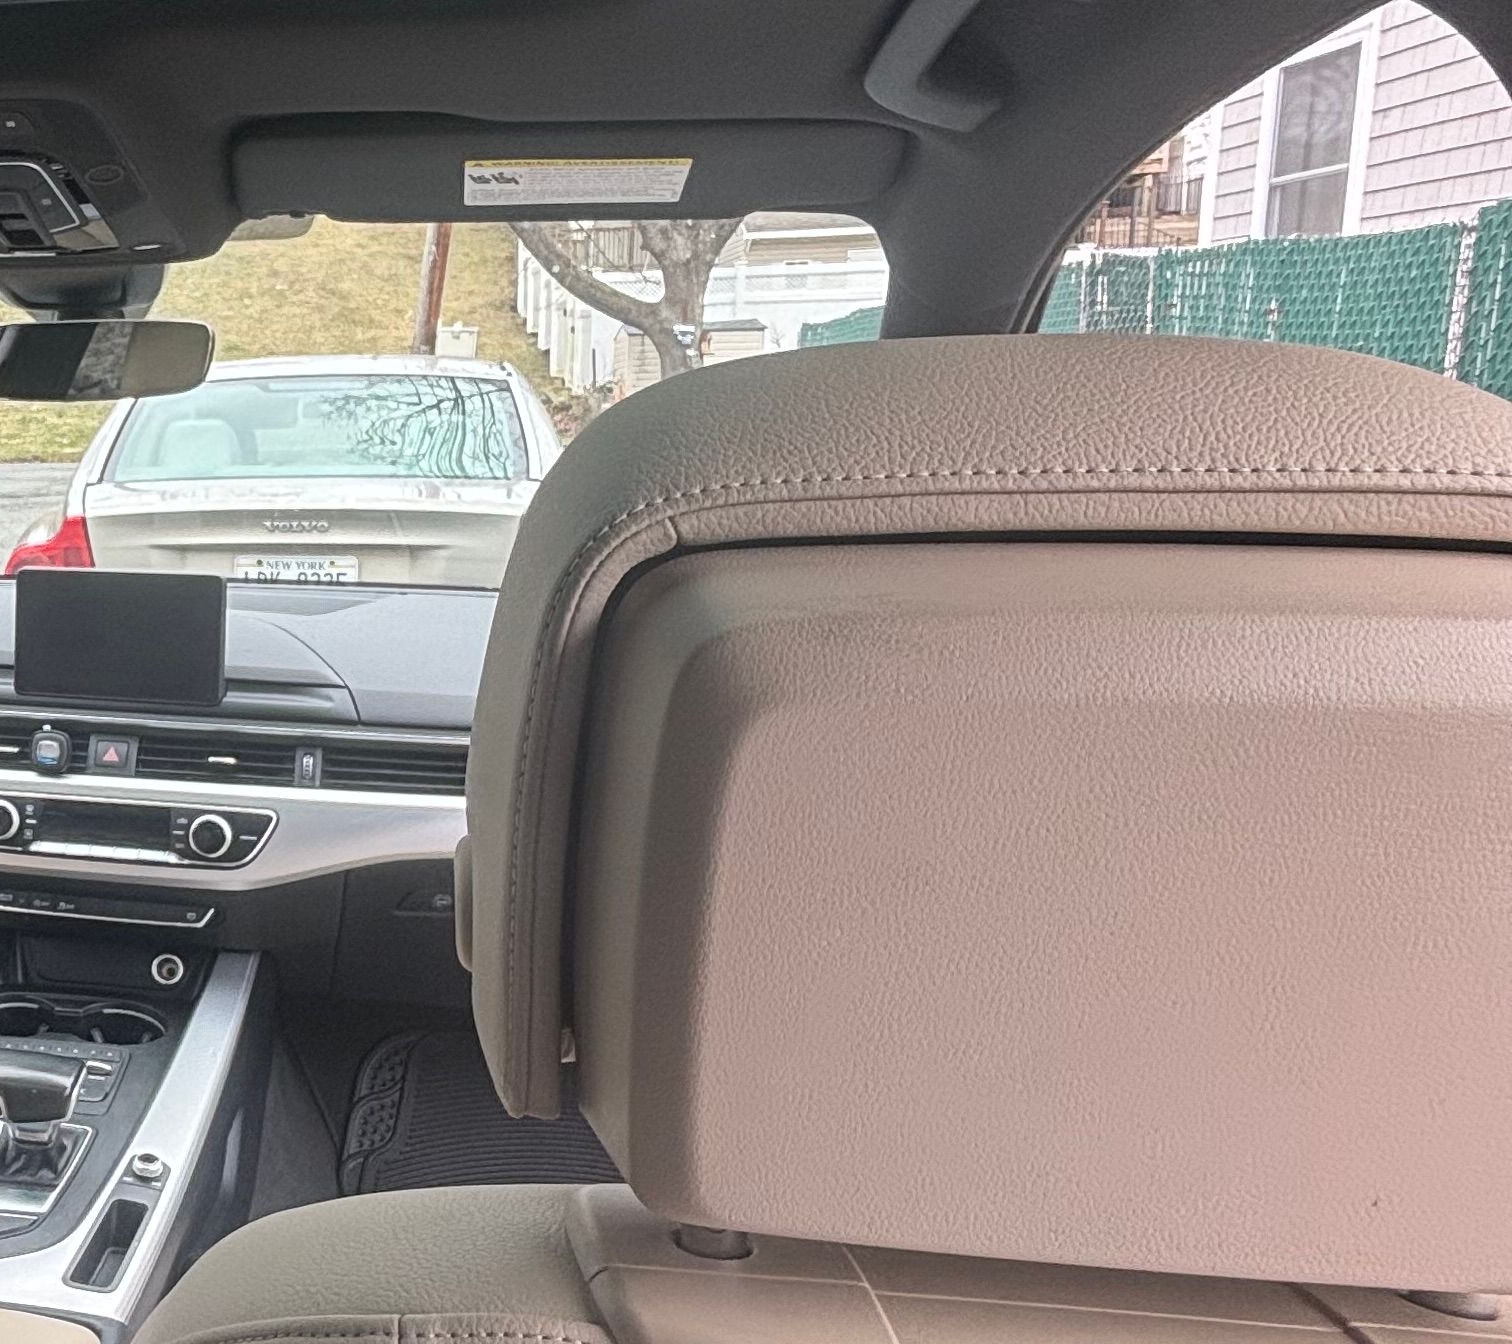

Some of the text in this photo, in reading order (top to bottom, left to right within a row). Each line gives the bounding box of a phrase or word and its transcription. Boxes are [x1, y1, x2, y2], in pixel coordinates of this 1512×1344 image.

[262, 521, 329, 533] VOLVO
[266, 560, 326, 570] NEW YORK
